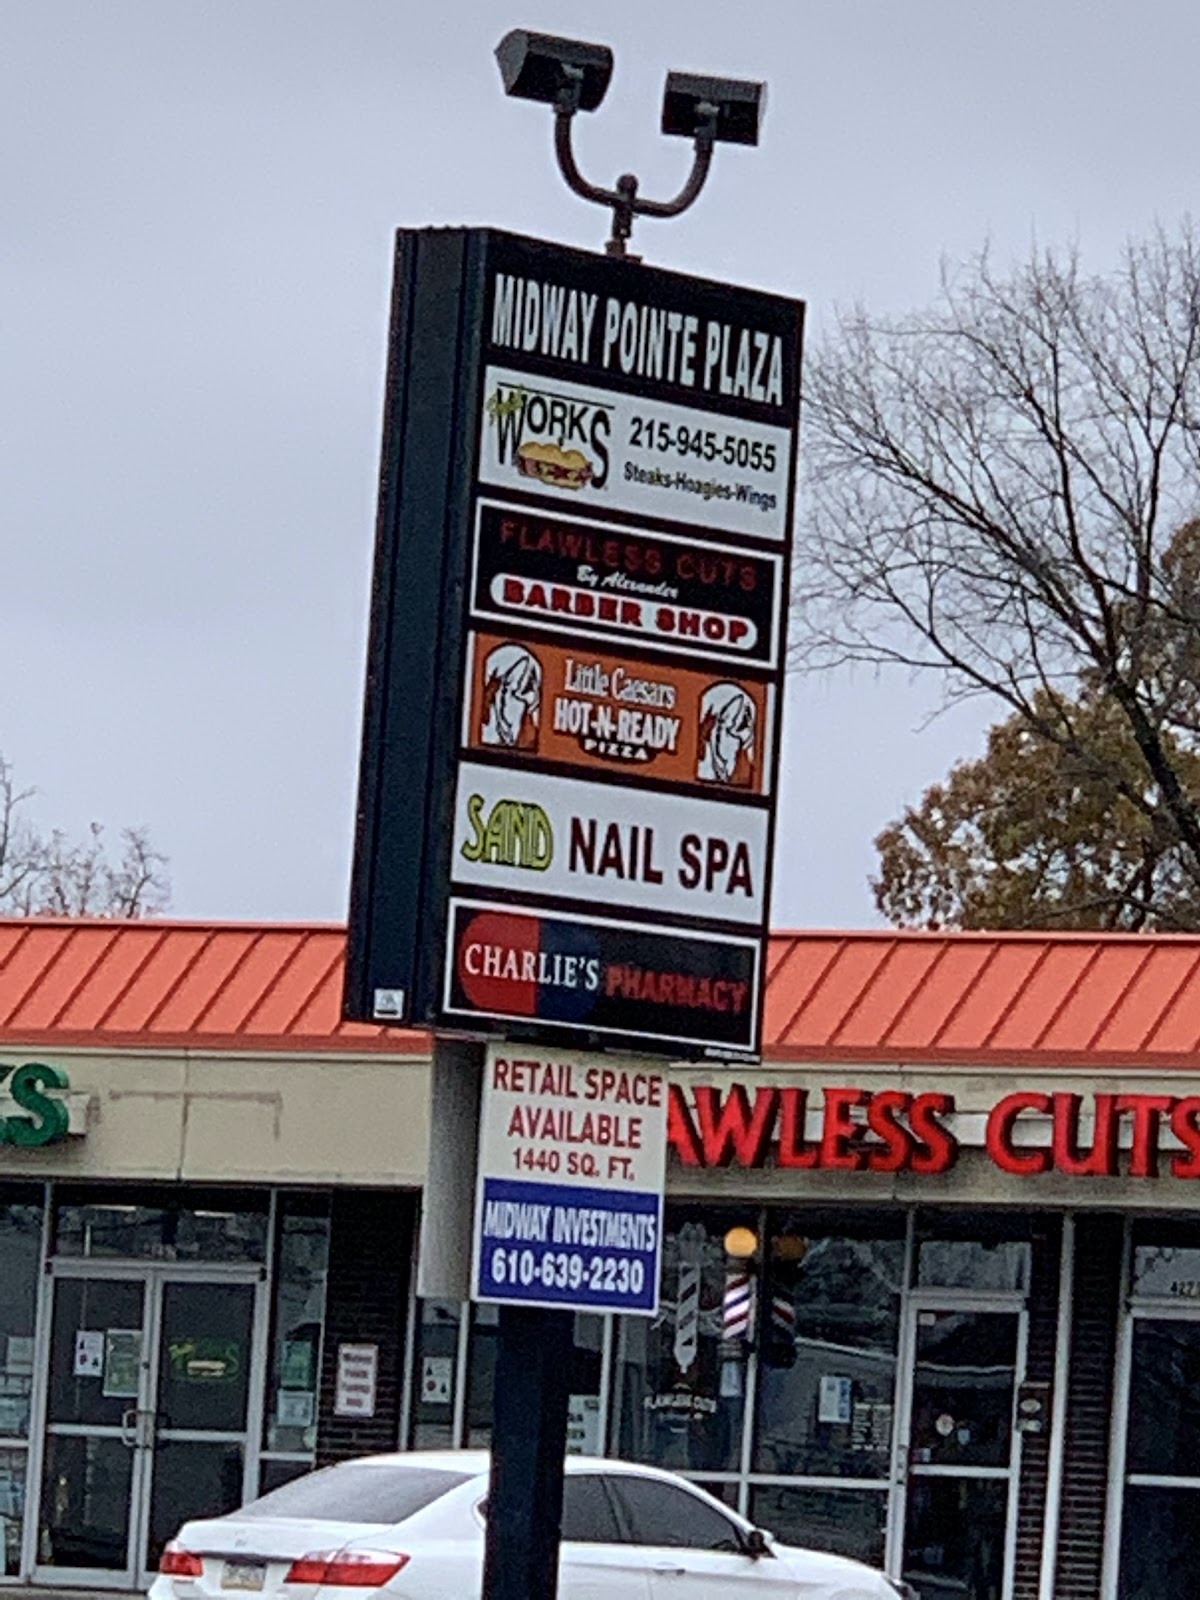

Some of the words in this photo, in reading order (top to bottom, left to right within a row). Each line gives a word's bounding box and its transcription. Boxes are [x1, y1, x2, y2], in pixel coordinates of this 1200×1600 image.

[491, 273, 598, 363] MIDWAY
[603, 299, 699, 387] POINTE
[703, 321, 783, 406] PLAZA
[629, 416, 777, 473] 215-945-5055
[500, 519, 662, 574] FLAWLESS
[676, 552, 758, 592] CUTS
[502, 577, 643, 628] BARBER
[656, 608, 748, 643] SHOP
[564, 658, 608, 696] Little
[610, 667, 676, 710] Caesars
[553, 697, 681, 751] HOT-N-READY
[584, 738, 648, 760] PIZZA
[460, 793, 553, 871] SAND
[569, 816, 663, 884] NAIL
[678, 834, 754, 898] SPA
[464, 944, 599, 992] CHARLIE'S
[605, 965, 746, 1014] PHARMACY
[493, 1059, 578, 1098] RETAIL
[585, 1068, 662, 1108] SPACE
[507, 1105, 643, 1149] AVAILABLE
[986, 1091, 1200, 1179] CUTS
[513, 1148, 560, 1174] 1440
[608, 1156, 636, 1182] FT.
[483, 1201, 551, 1242] MIDWAY
[553, 1206, 656, 1253] INVESTMENTS
[491, 1248, 644, 1295] 610-639-2230
